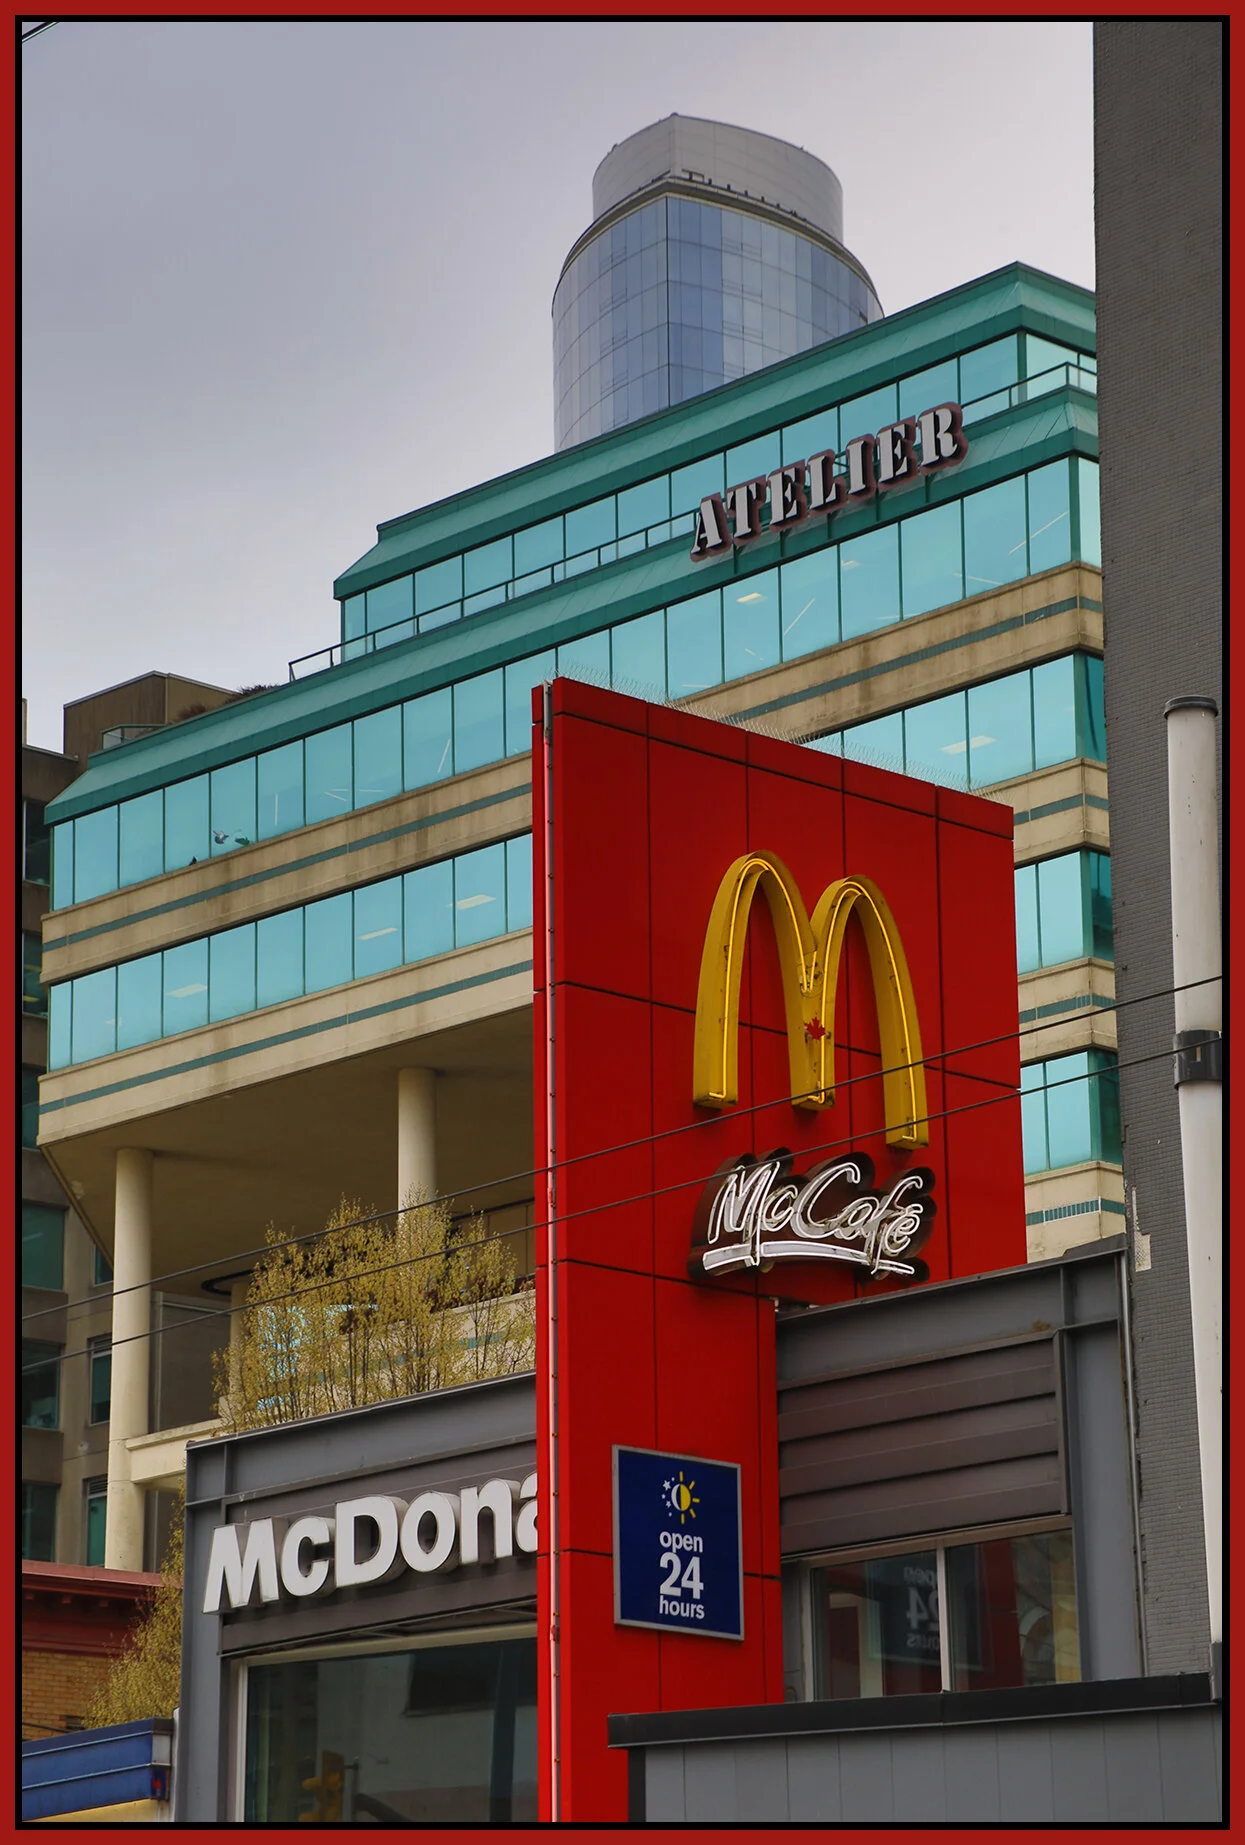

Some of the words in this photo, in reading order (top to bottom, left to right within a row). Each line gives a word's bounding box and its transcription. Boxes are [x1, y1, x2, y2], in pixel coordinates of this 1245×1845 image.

[690, 405, 964, 558] ATELIER
[659, 1531, 703, 1554] open
[659, 1552, 704, 1600] 24
[659, 1595, 705, 1619] hours
